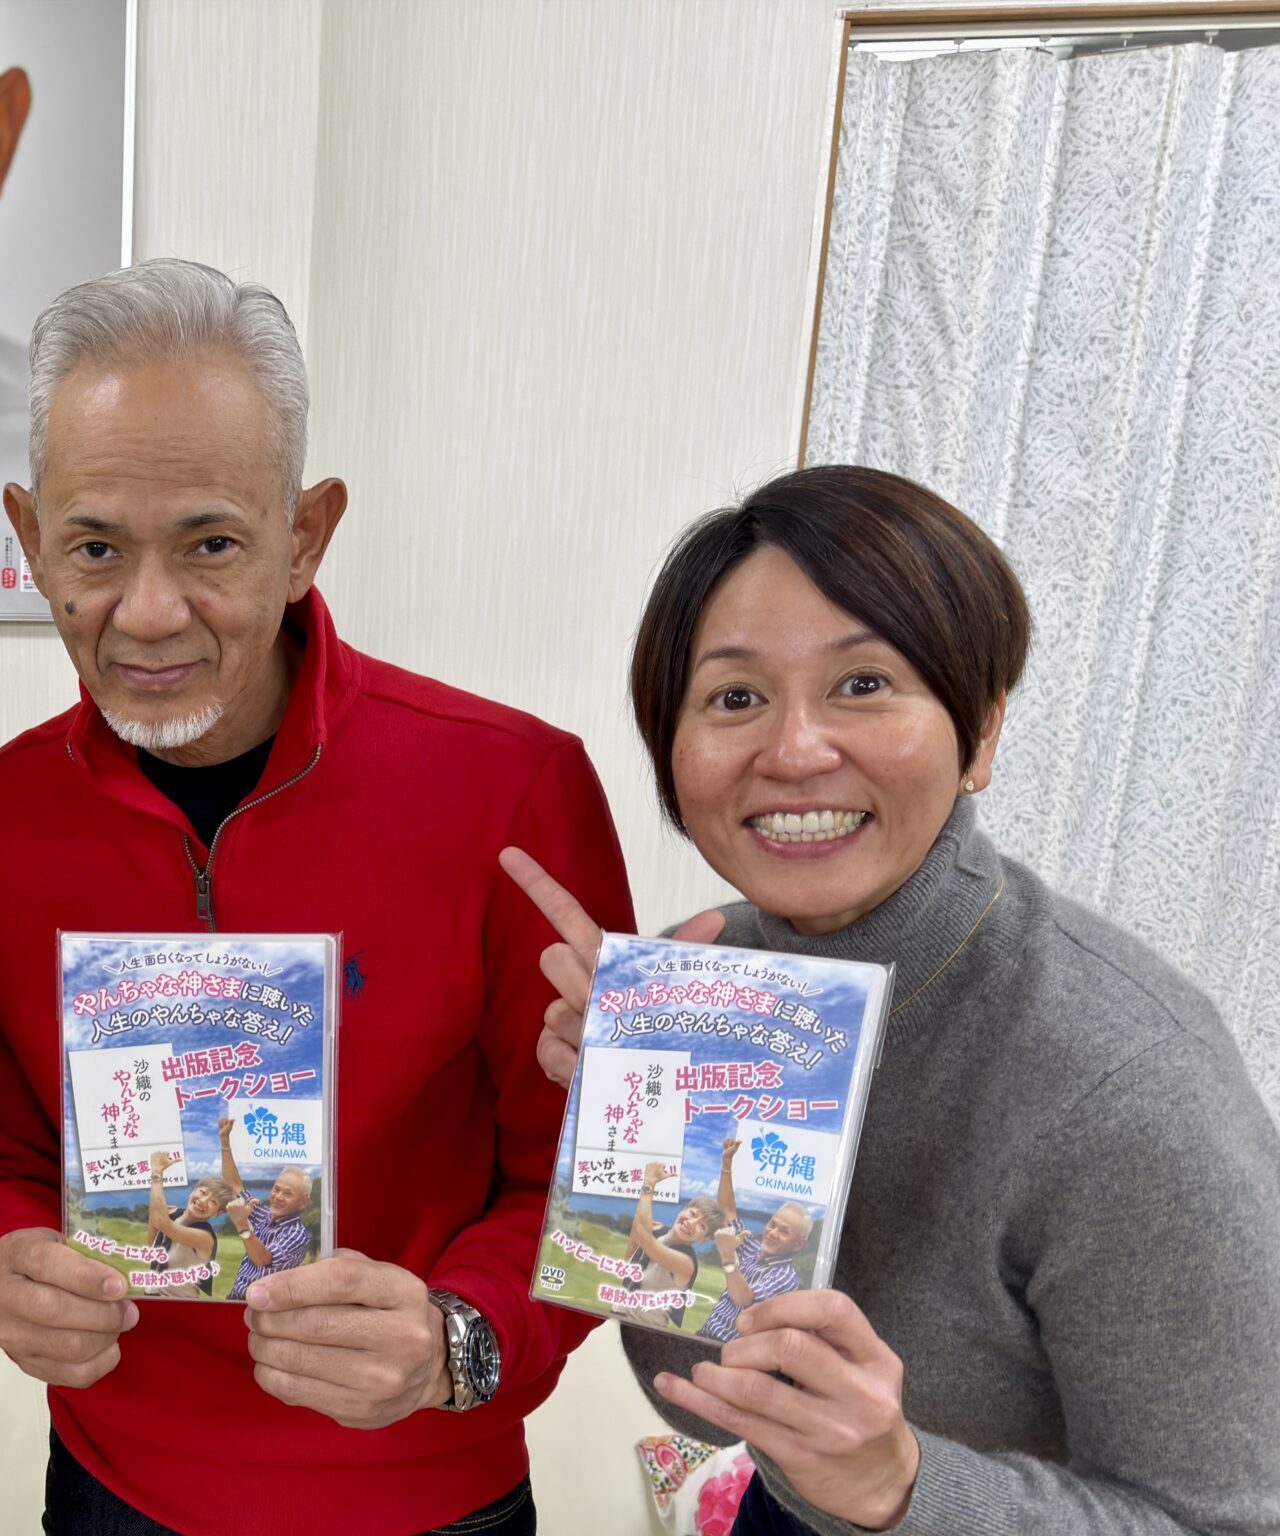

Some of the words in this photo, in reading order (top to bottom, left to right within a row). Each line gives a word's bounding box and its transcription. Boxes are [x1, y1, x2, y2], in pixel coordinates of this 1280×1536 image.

[73, 970, 313, 1027] やんちゃな神さまに聴いた
[599, 980, 849, 1054] やんちゃな神さまに聴いた
[133, 1059, 152, 1102] 沙織の
[161, 1040, 263, 1082] 出版記念
[675, 1061, 783, 1091] 出版記念
[112, 1069, 141, 1139] やんちゃな
[173, 1069, 316, 1109] トークショー
[645, 1064, 663, 1108] 沙織の
[101, 1103, 120, 1149] 神さま
[604, 1104, 624, 1152] 神さま
[623, 1072, 645, 1145] やんちゃな
[683, 1094, 838, 1122] トークショー
[253, 1148, 307, 1159] OKINAWA
[255, 1122, 307, 1146] 沖縄
[85, 1153, 121, 1174] 笑いが
[578, 1157, 615, 1174] 笑いが
[759, 1150, 817, 1181] 沖縄
[755, 1176, 813, 1196] OKINAWA
[75, 1231, 169, 1262] ハッピーになる
[552, 1231, 643, 1281] ハッピーになる
[542, 1266, 564, 1278] DVD
